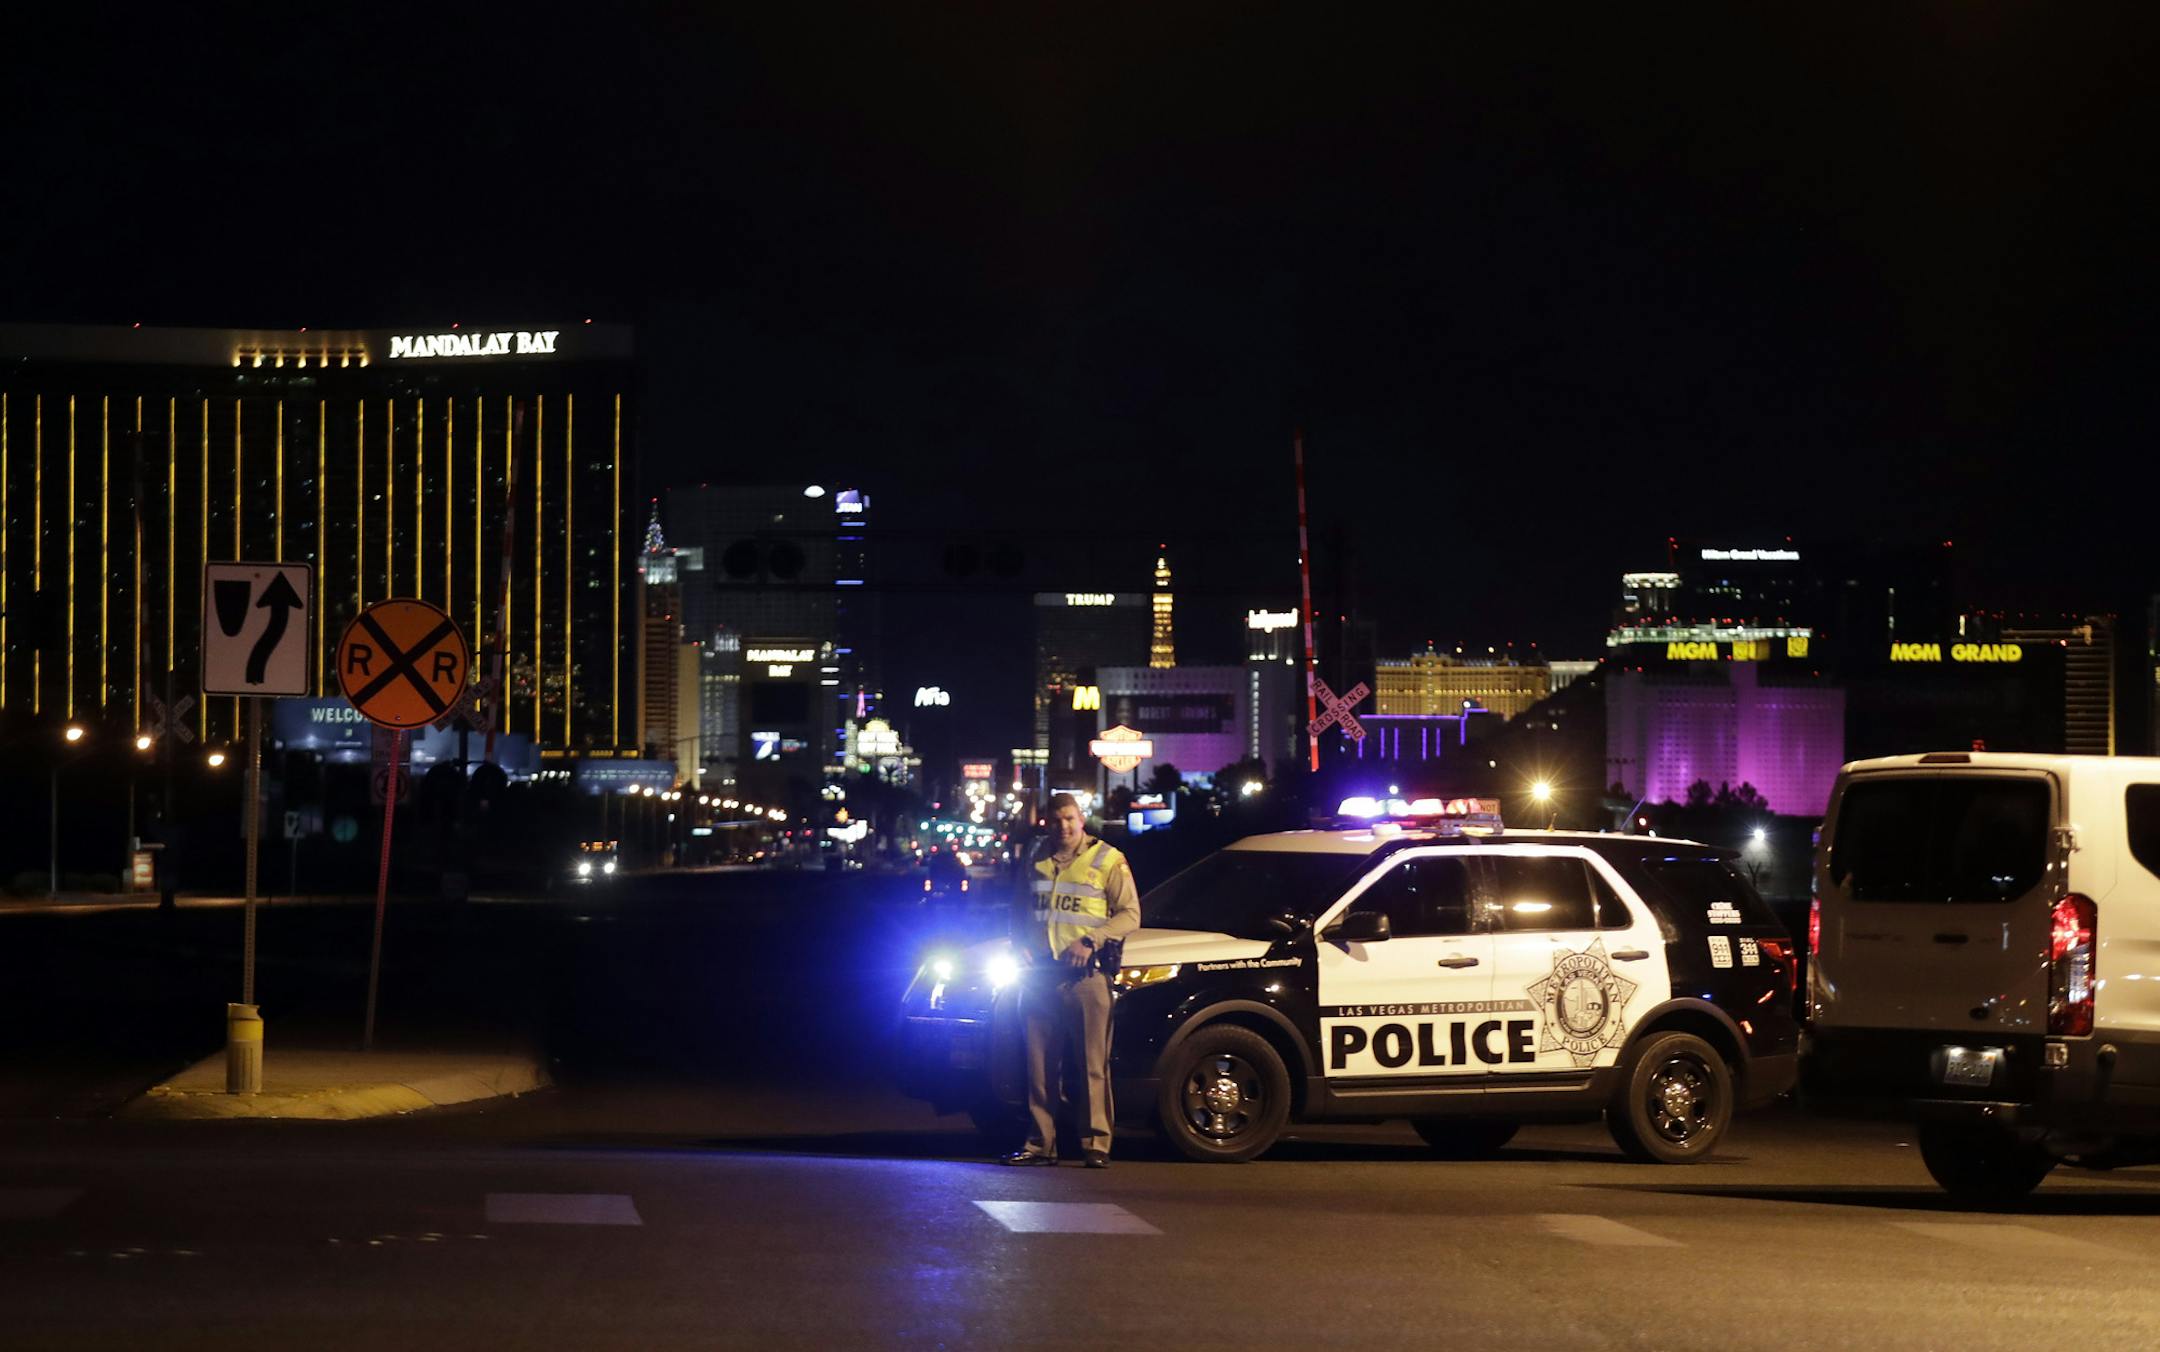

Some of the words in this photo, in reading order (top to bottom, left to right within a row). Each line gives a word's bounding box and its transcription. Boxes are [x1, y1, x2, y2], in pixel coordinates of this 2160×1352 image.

[389, 333, 514, 358] MANDALAY
[516, 331, 560, 354] BAY
[1065, 593, 1115, 606] TRUMP
[1667, 641, 1718, 661] MGM
[1890, 643, 1942, 662] MGM
[1951, 643, 2023, 662] GRAND
[347, 643, 372, 676] R
[431, 651, 458, 684] R
[1311, 687, 1364, 733] CROSSING
[1312, 681, 1333, 706] RAIL
[1340, 714, 1363, 739] ROAD
[1197, 961, 1229, 972] Partners
[1229, 959, 1247, 970] with
[1246, 959, 1260, 969] the
[1260, 957, 1303, 969] Community
[1546, 956, 1619, 1004] METROPOLITAN
[1339, 1006, 1363, 1017] LAS
[1370, 1004, 1414, 1016] VEGAS
[1420, 1001, 1525, 1014] METROPOLITAN
[1331, 1019, 1535, 1069] POLICE
[1562, 1032, 1607, 1053] POLICE
